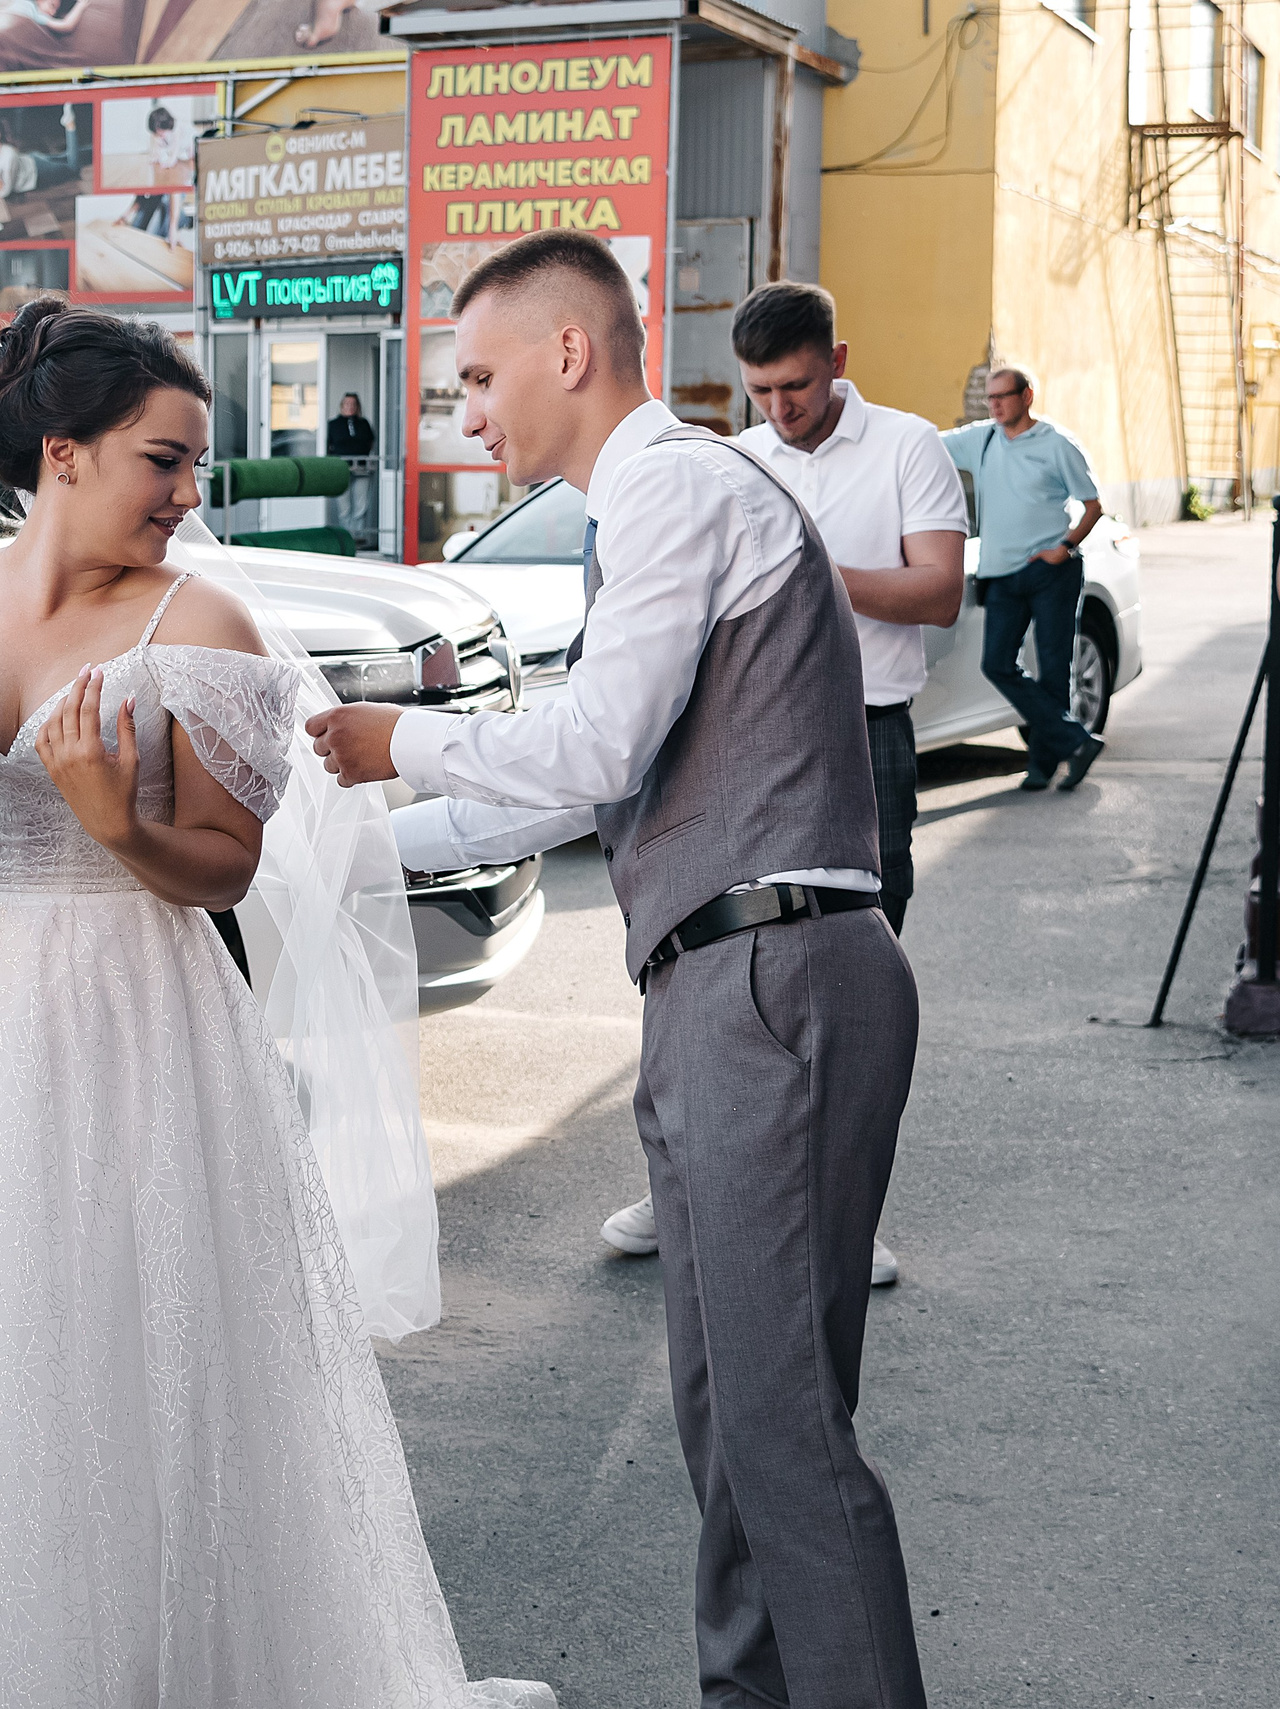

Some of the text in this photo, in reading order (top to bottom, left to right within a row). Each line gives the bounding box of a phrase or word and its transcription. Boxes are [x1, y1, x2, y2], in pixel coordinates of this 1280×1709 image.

[427, 53, 652, 99] ЛИНОЛЕУМ
[285, 130, 367, 155] ФЕНИКС-М
[437, 105, 640, 148] ЛАМИНАТ
[205, 151, 405, 203] МЯГКАЯ МЕБЕ
[423, 155, 652, 192] КЕРАМИЧЕСКАЯ
[205, 202, 249, 220] СТОЛЫ
[255, 196, 302, 215] СТУЛЬЯ
[306, 190, 370, 211] КРОВАТИ
[446, 196, 621, 235] ПЛИТКА
[205, 218, 272, 239] ВОЛГОГРАД
[277, 211, 352, 233] КРАСНОДАР
[212, 271, 373, 313] LVT покрытия
